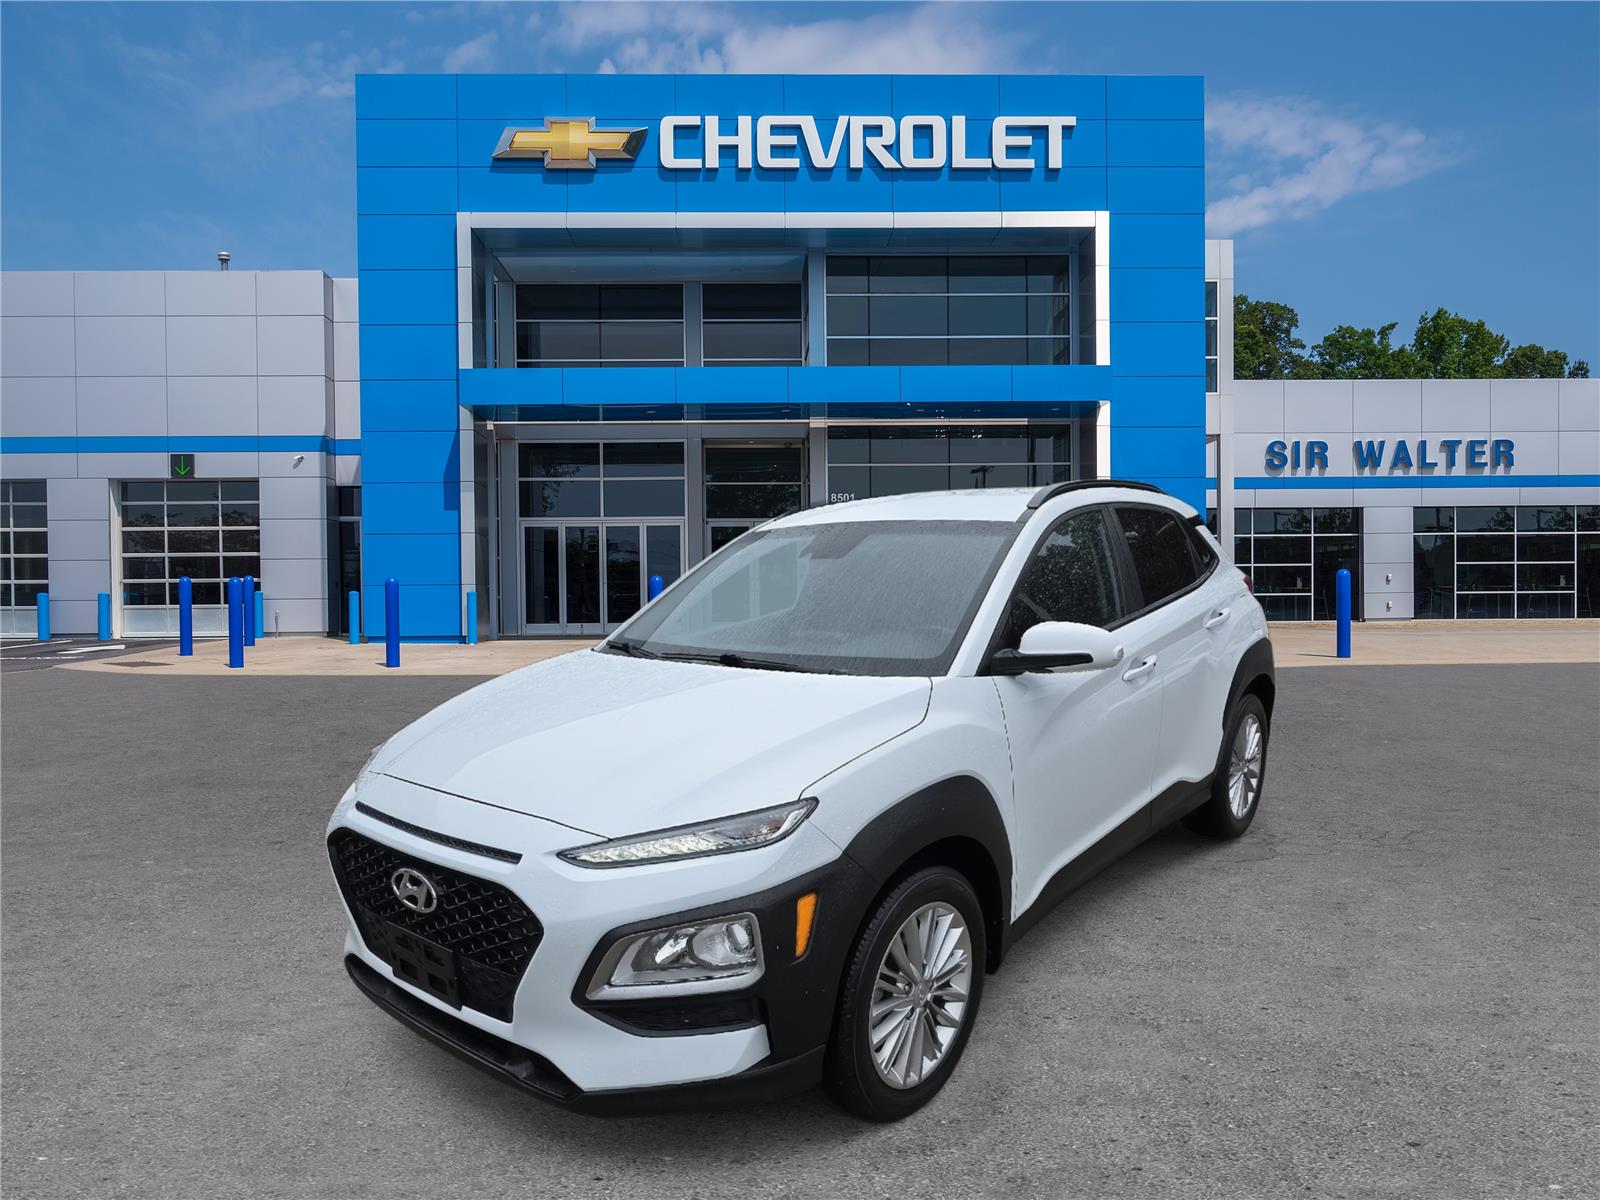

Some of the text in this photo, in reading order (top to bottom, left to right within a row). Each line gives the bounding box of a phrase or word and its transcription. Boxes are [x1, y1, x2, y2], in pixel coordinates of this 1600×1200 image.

[659, 115, 1077, 169] CHEVROLET
[1265, 439, 1515, 469] SIR WALTER
[830, 493, 855, 502] 8501
